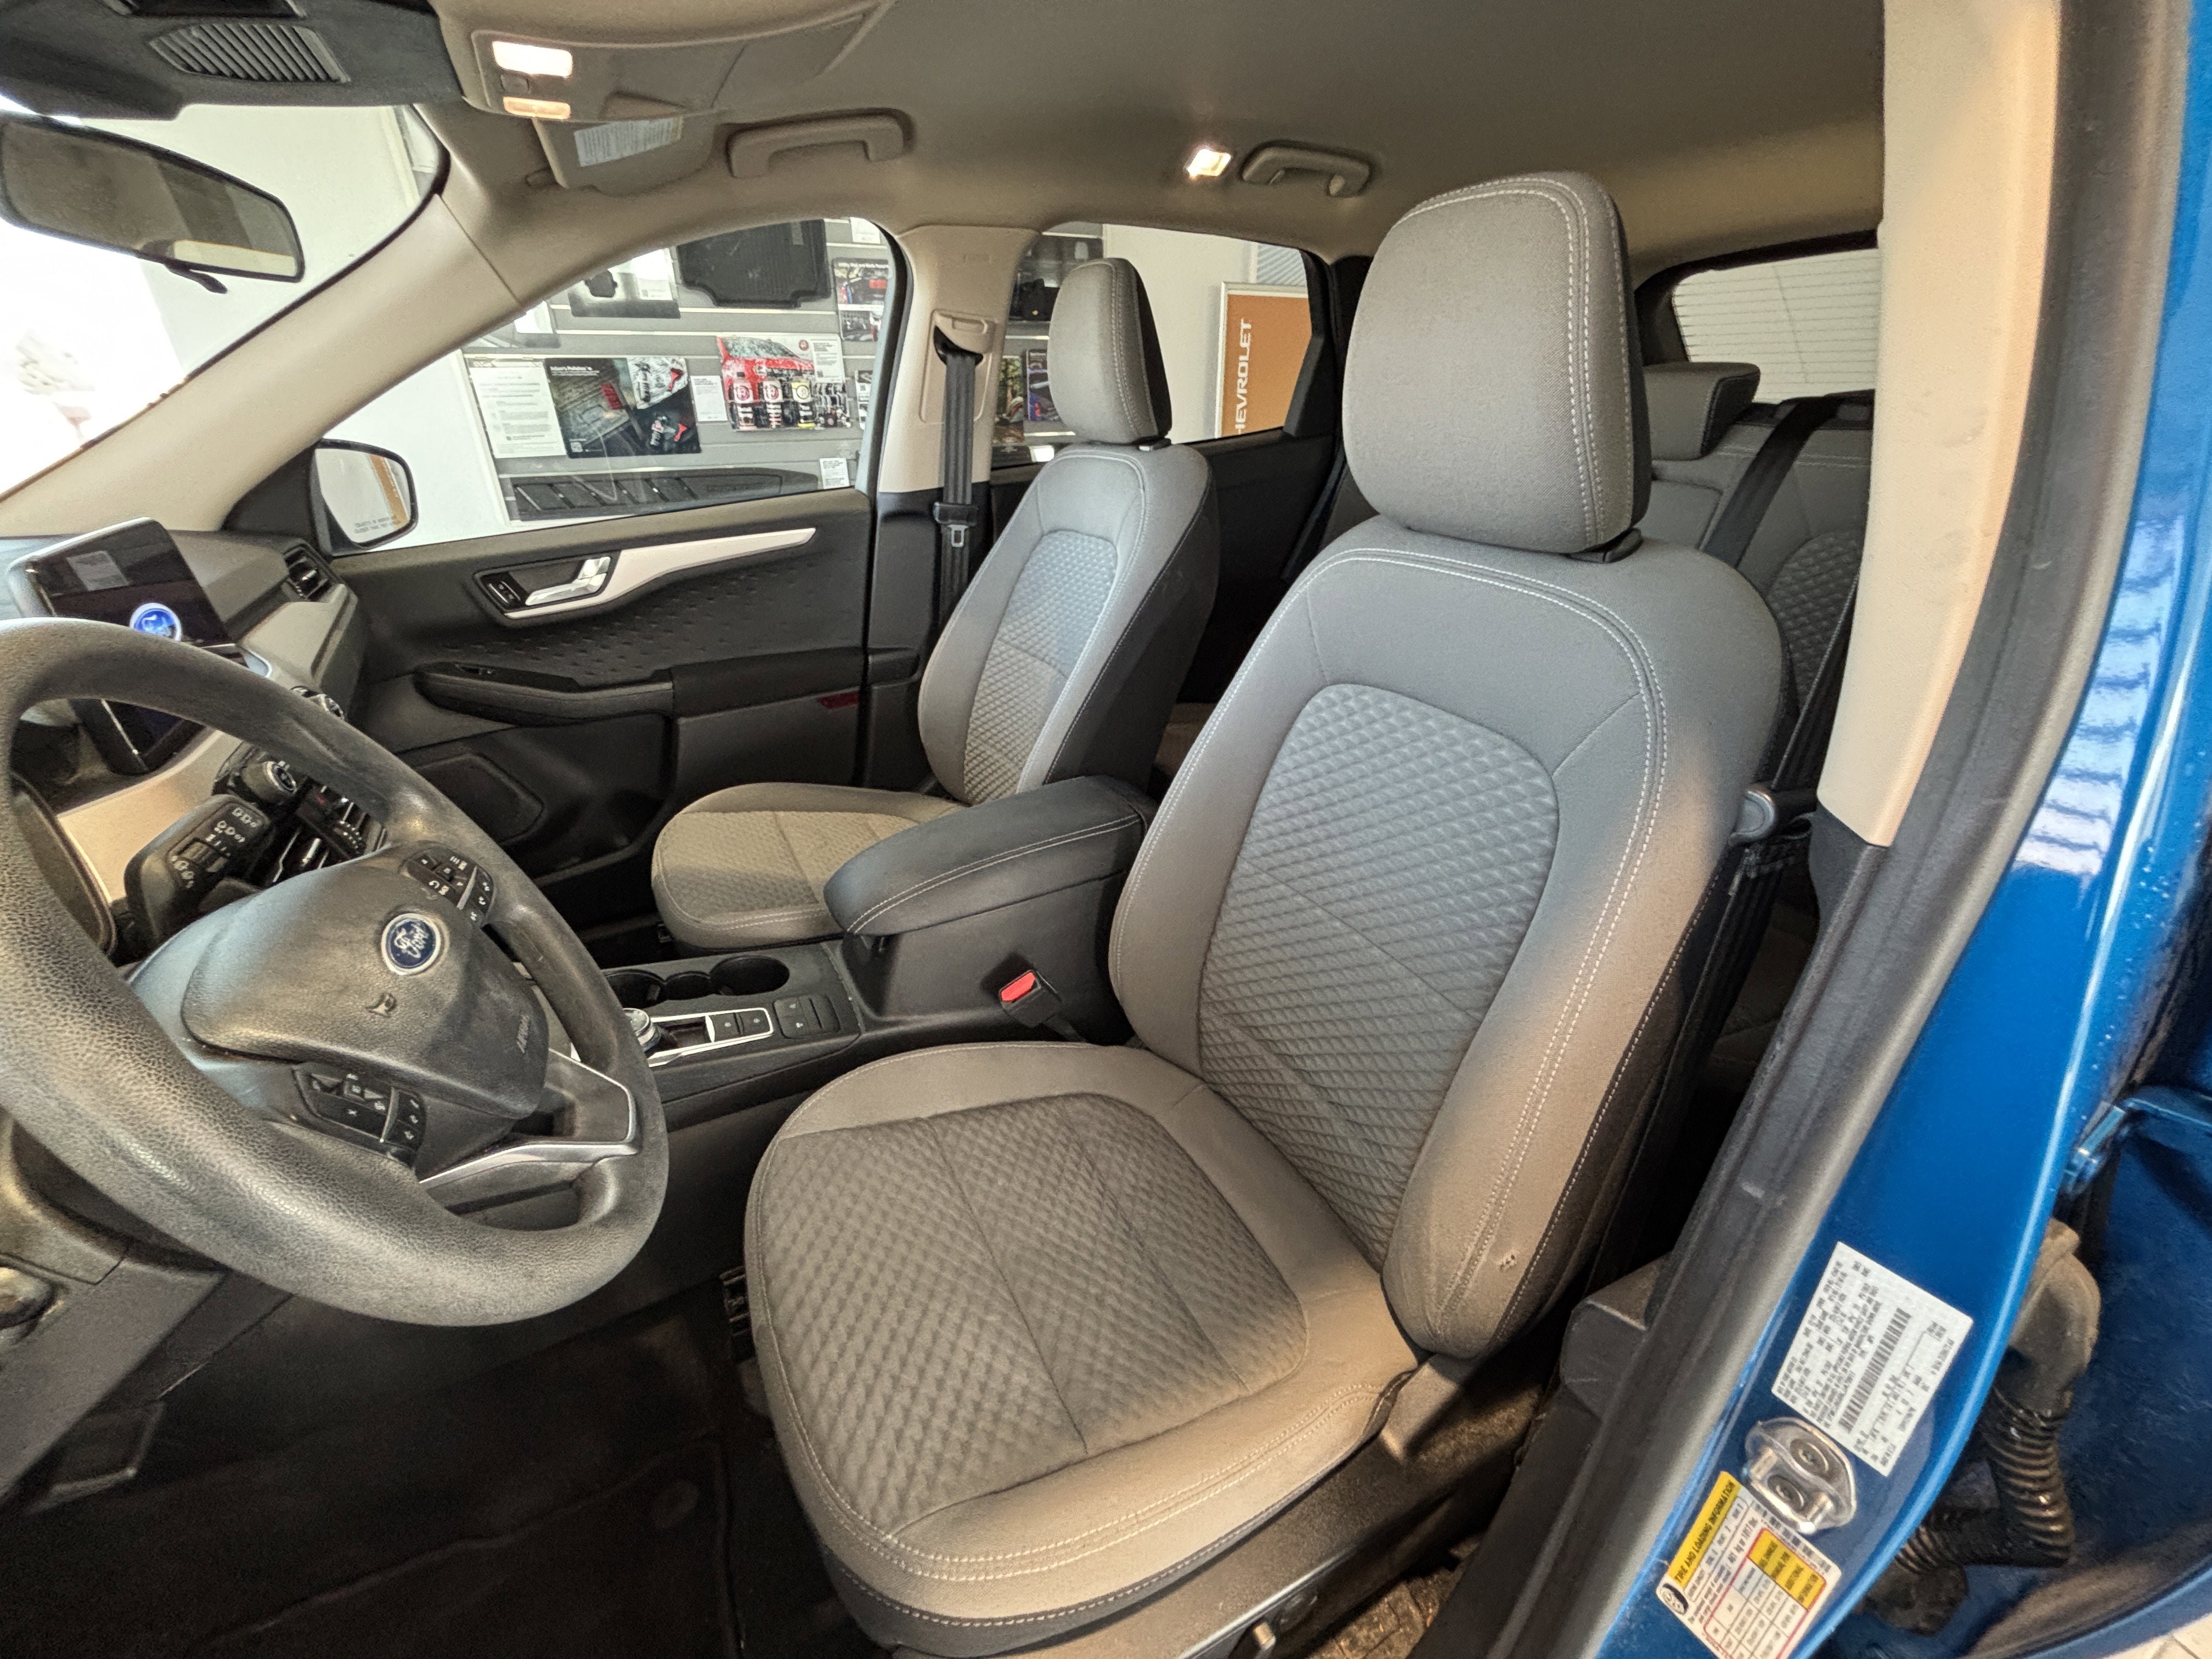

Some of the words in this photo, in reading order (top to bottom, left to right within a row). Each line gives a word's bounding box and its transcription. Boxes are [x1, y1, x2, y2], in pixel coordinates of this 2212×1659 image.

[1235, 318, 1251, 435] HEVROLET
[1675, 1565, 1688, 1584] TIRE
[1684, 1550, 1697, 1568] AND
